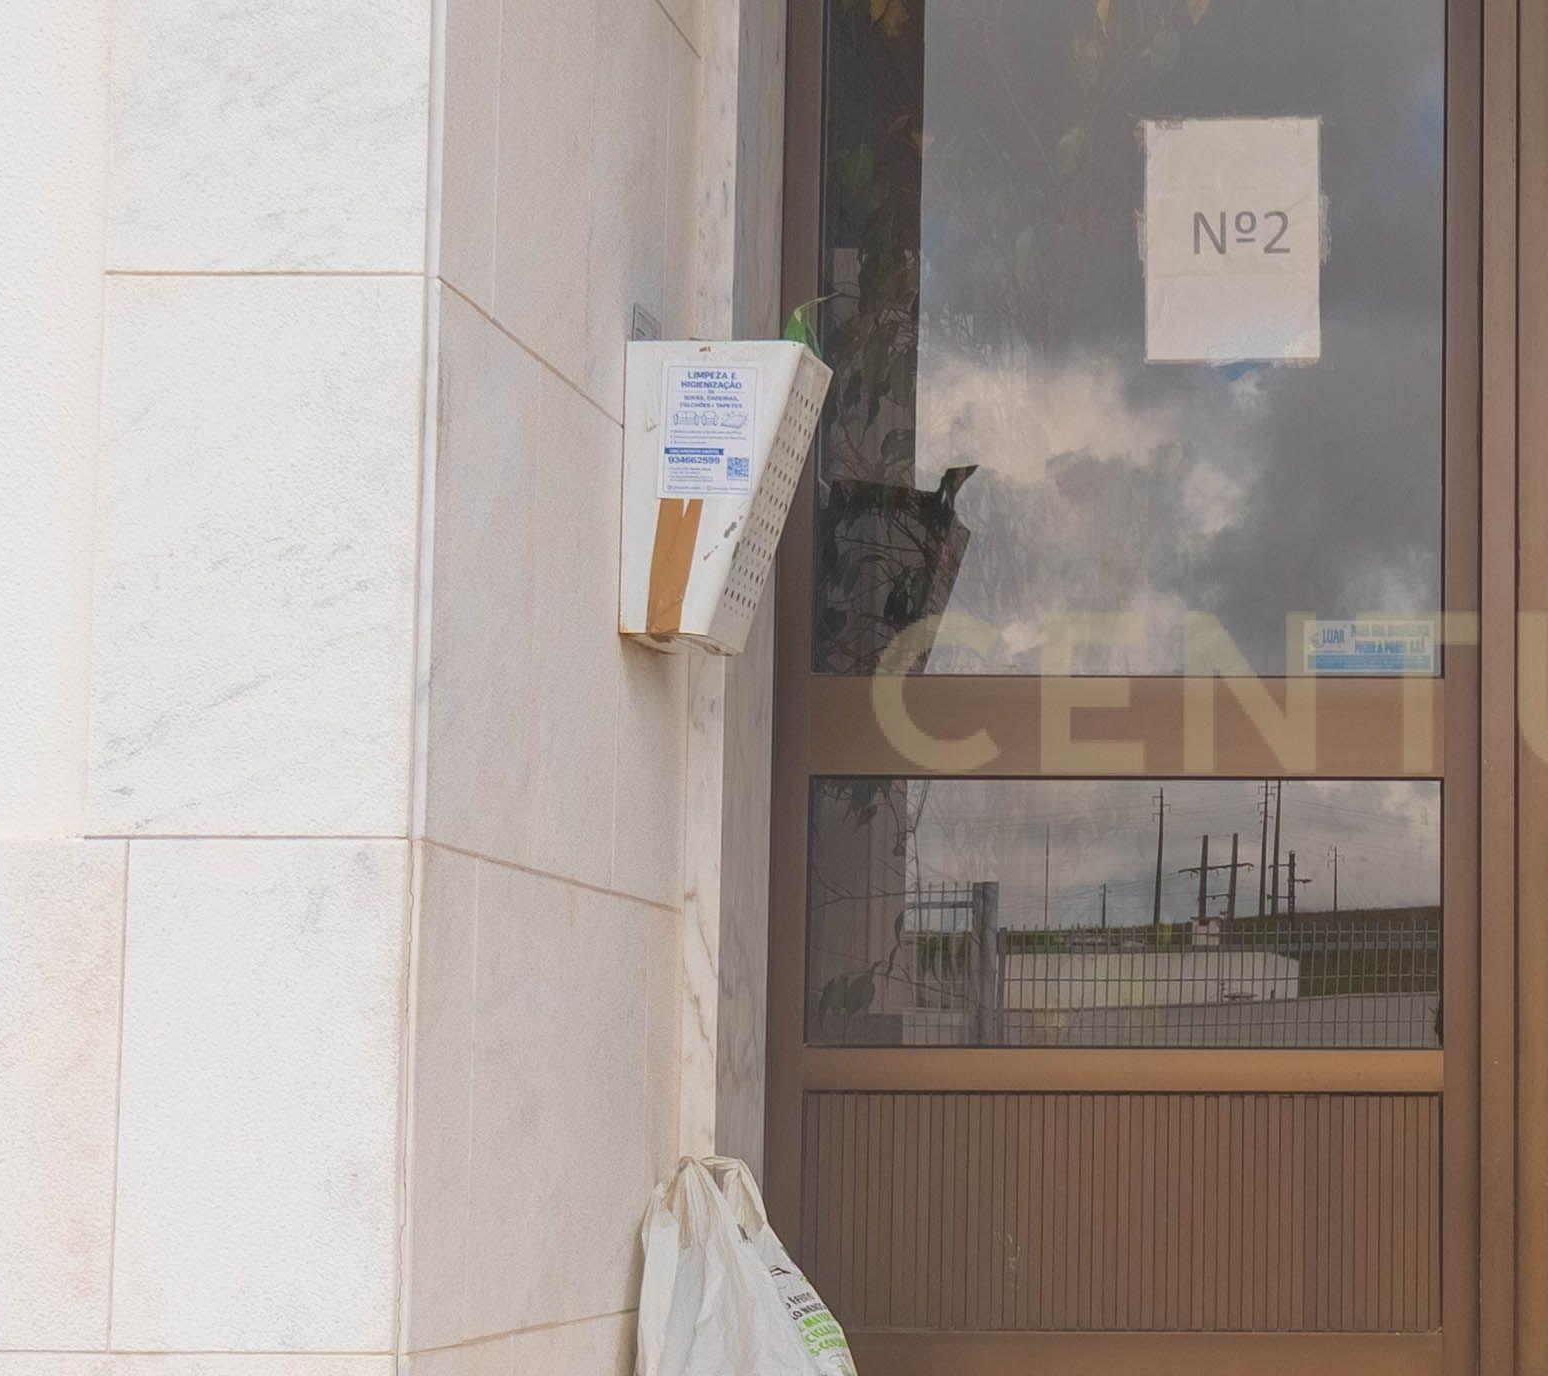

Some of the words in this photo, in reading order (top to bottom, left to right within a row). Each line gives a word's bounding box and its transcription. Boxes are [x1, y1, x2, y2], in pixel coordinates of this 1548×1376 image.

[1192, 210, 1291, 255] Nº2
[687, 371, 728, 380] LIMPEZA
[731, 371, 737, 379] E
[680, 380, 742, 390] HIGIENIZAÇÃO
